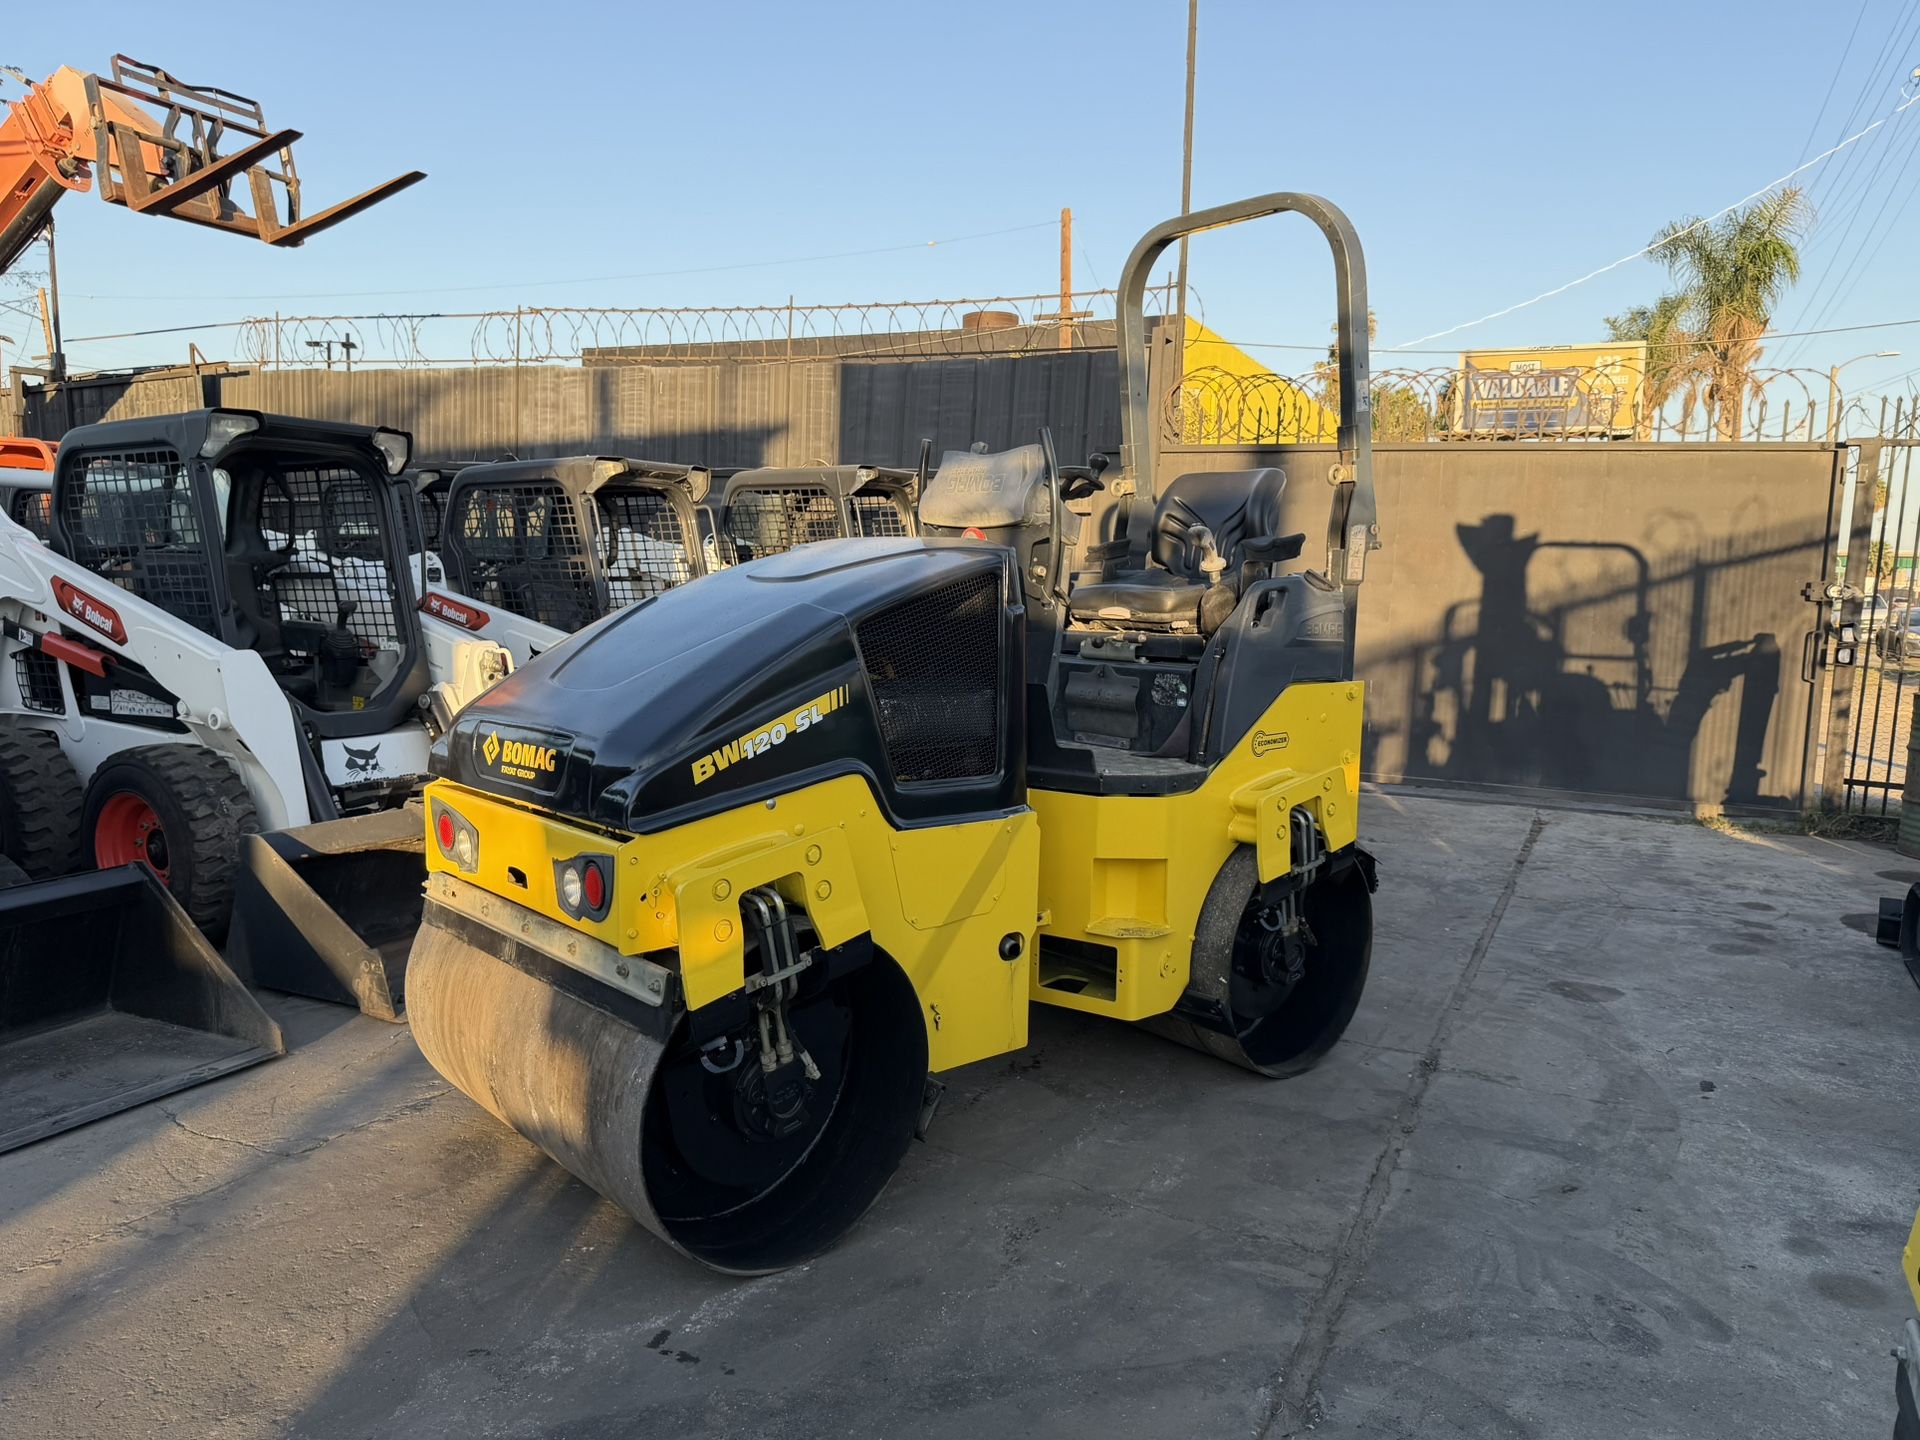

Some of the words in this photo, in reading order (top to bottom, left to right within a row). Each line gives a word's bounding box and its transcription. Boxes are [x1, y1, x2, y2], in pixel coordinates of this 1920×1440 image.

[1516, 363, 1537, 373] MOST
[1477, 376, 1569, 399] VALUABLE
[85, 606, 113, 633] Bobcat
[442, 605, 467, 624] Bobcat
[795, 706, 823, 733] SL
[1257, 737, 1287, 747] ECONOMIZER
[502, 740, 557, 772] BOMAG
[517, 768, 536, 780] GROUP
